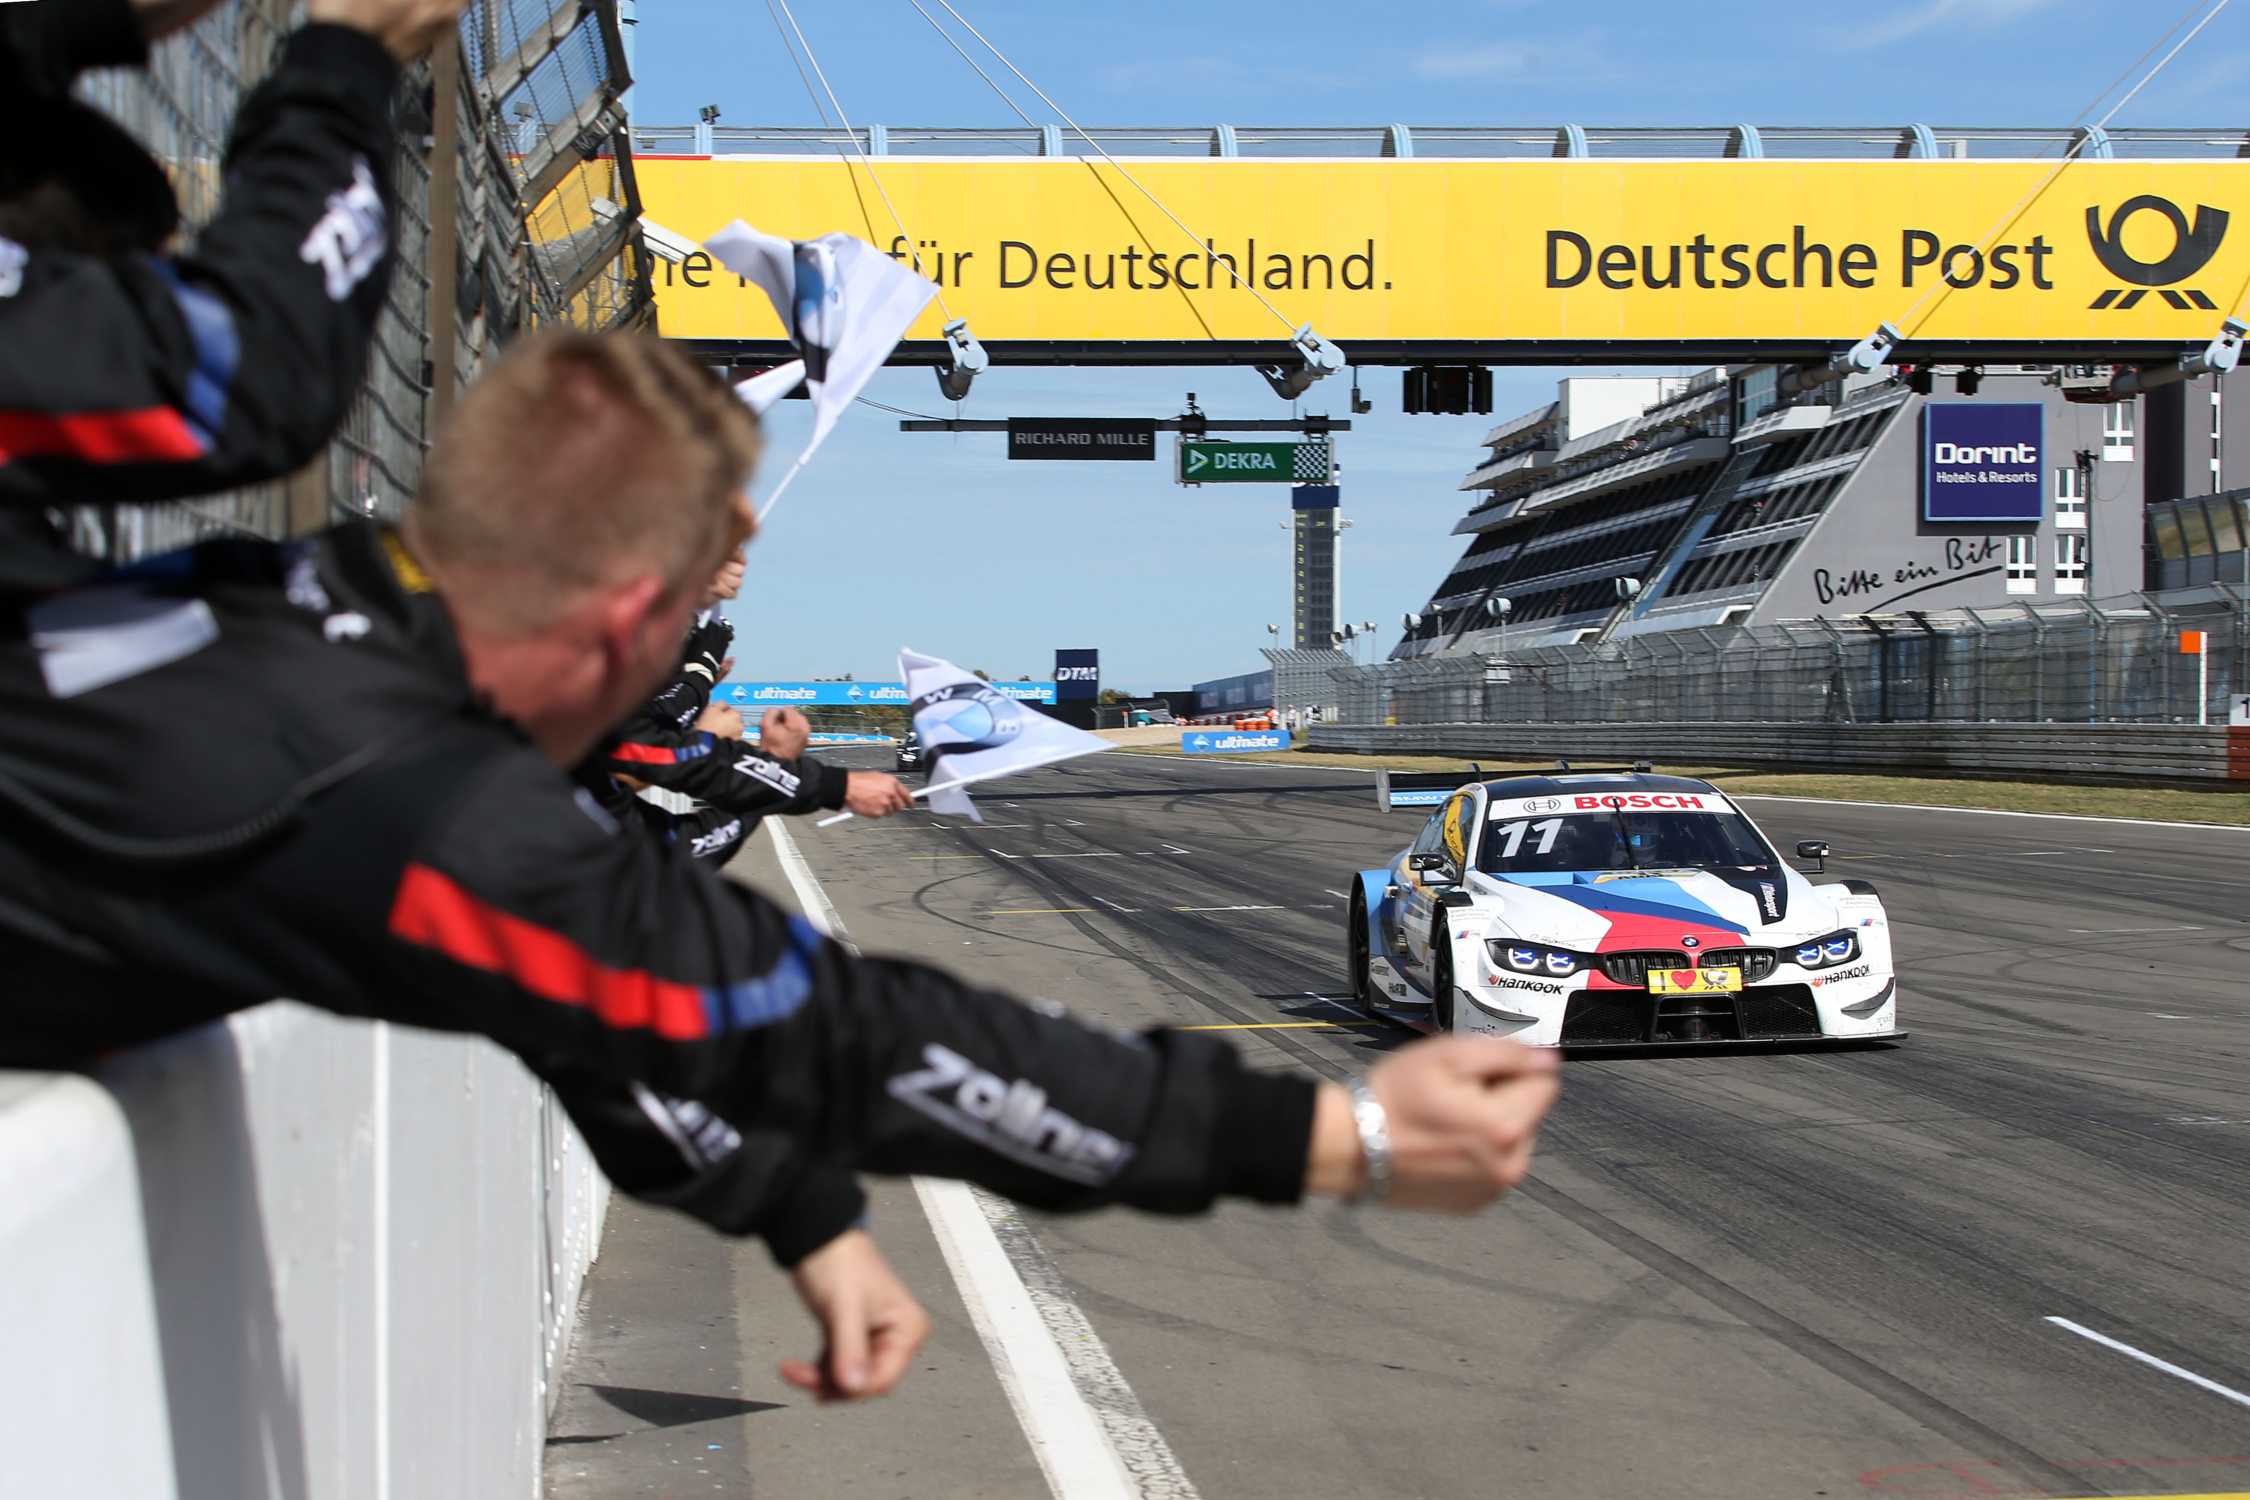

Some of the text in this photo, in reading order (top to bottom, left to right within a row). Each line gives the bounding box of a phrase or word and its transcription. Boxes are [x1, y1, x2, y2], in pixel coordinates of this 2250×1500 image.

[648, 250, 713, 288] ie
[1000, 238, 1394, 290] Deutschland.
[1545, 225, 2054, 289] Deutsche Post
[1015, 432, 1150, 445] RICHARD MILLE
[1213, 453, 1277, 469] DEKRA
[1935, 442, 2037, 464] Dorint
[1936, 471, 2038, 483] Hotels & Resorts
[1814, 536, 2001, 605] Bitte ein Bit
[1057, 666, 1098, 681] DTM
[754, 687, 817, 700] ultimate
[869, 687, 908, 700] ultim
[1215, 734, 1280, 749] ultimate
[1574, 795, 1705, 811] BOSCH
[1497, 818, 1565, 858] 11
